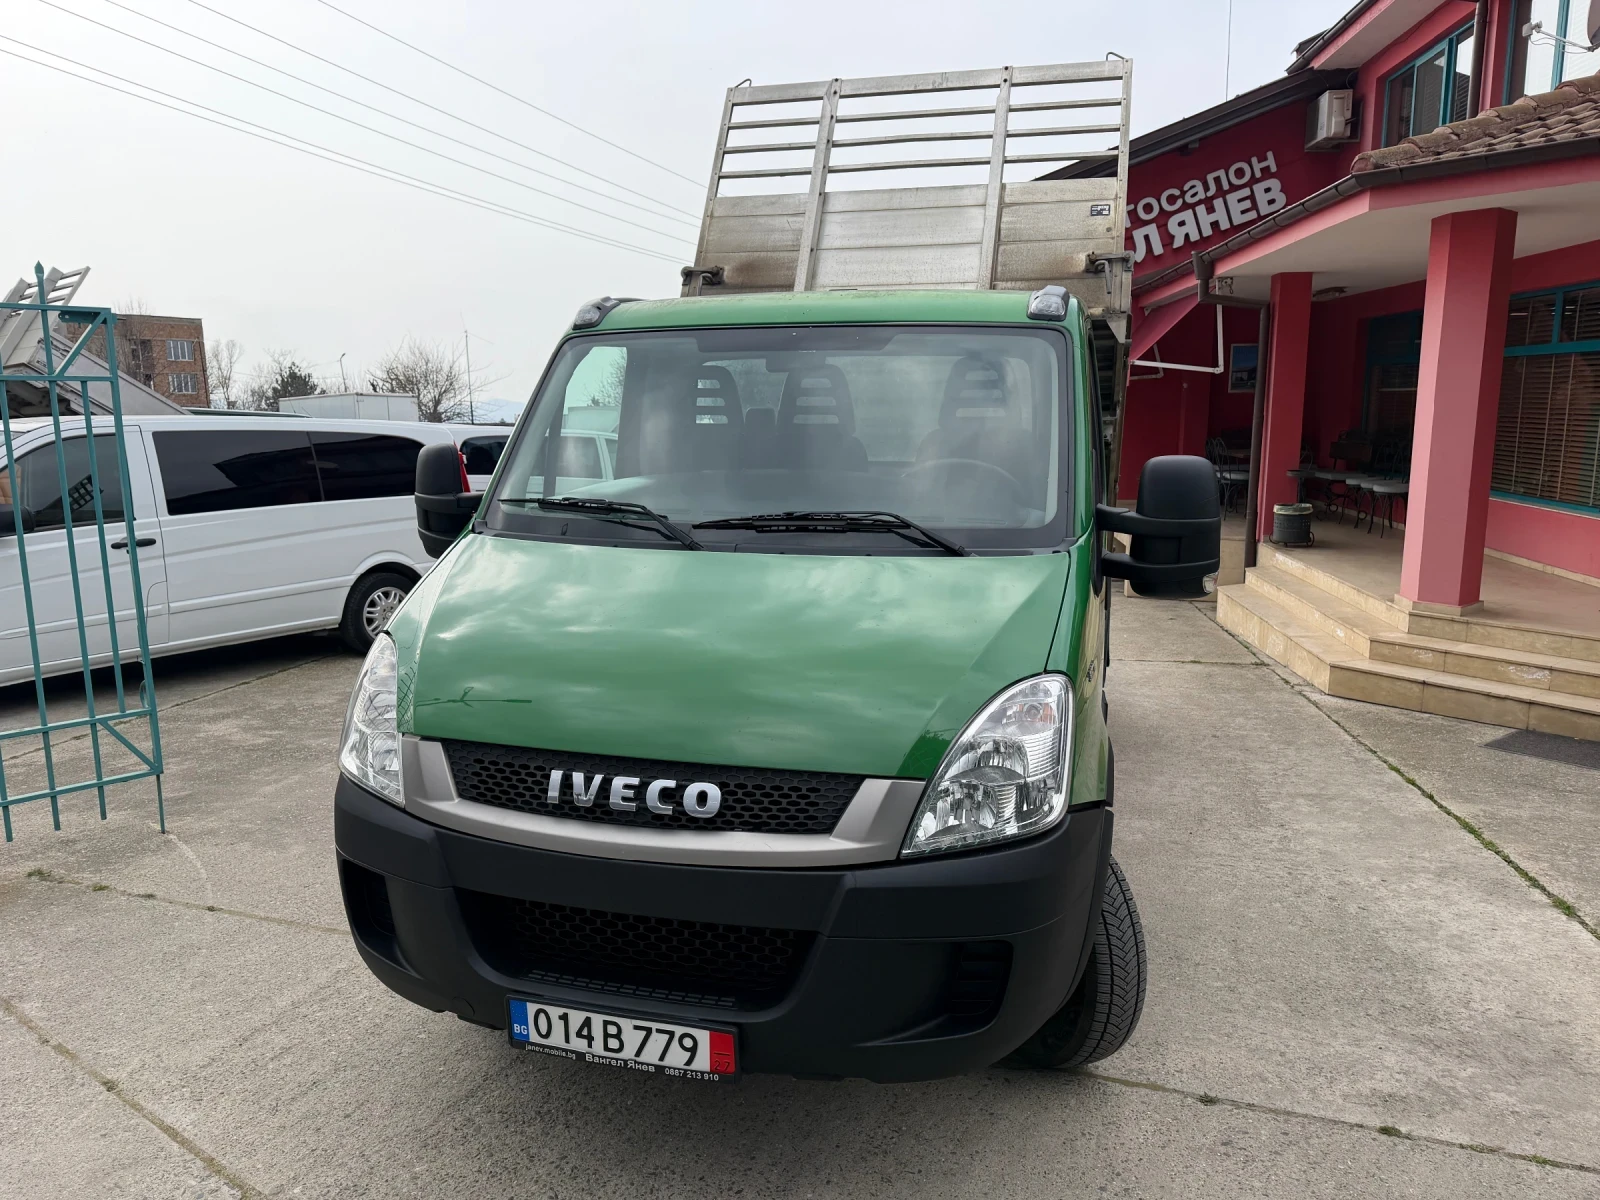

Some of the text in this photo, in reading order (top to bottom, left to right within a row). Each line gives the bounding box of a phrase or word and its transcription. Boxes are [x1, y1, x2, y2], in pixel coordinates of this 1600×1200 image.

[1167, 178, 1287, 249] ЯНЕВ
[547, 770, 722, 818] IVECO
[513, 1023, 528, 1035] BG
[585, 1053, 656, 1073] Вангел Янев
[664, 1068, 685, 1077] 0887
